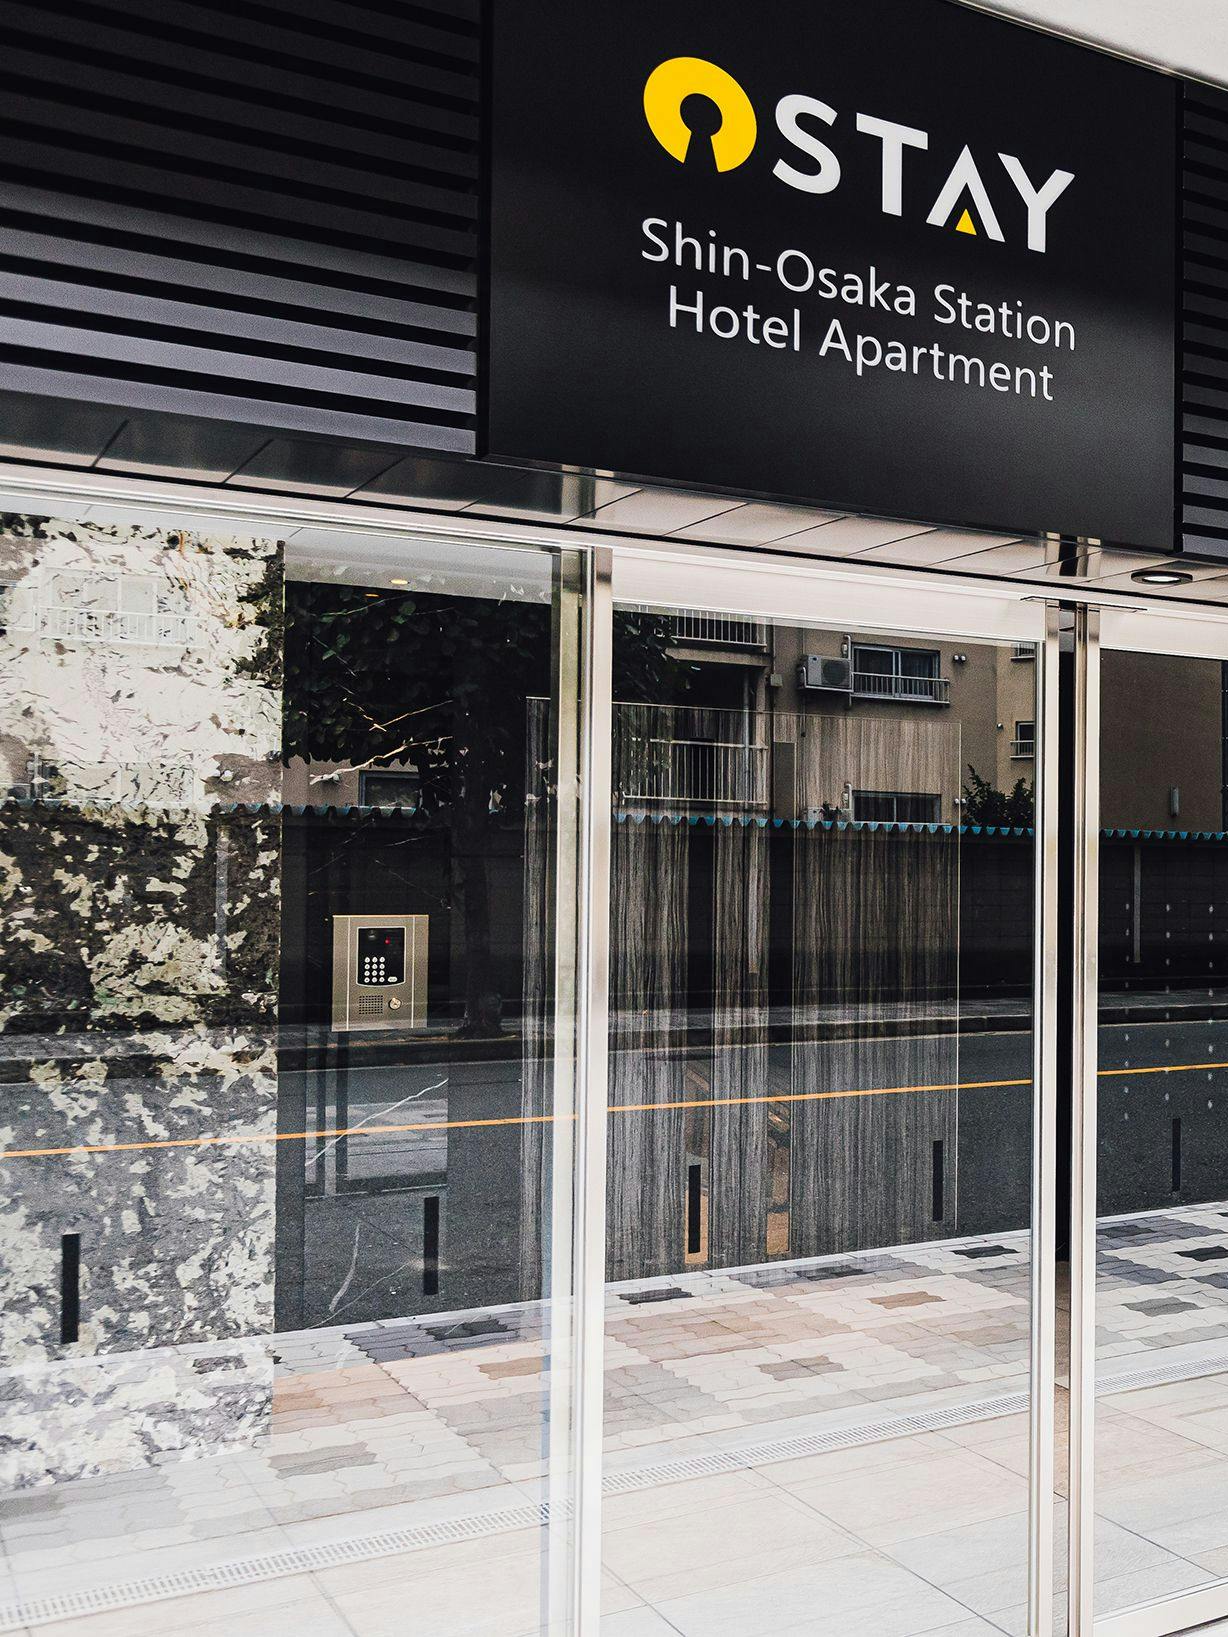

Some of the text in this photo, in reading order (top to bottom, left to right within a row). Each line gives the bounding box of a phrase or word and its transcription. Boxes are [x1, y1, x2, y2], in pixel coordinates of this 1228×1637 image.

[641, 217, 1075, 351] Shin-Osaka Station
[669, 284, 1054, 401] Hotel Apartment
